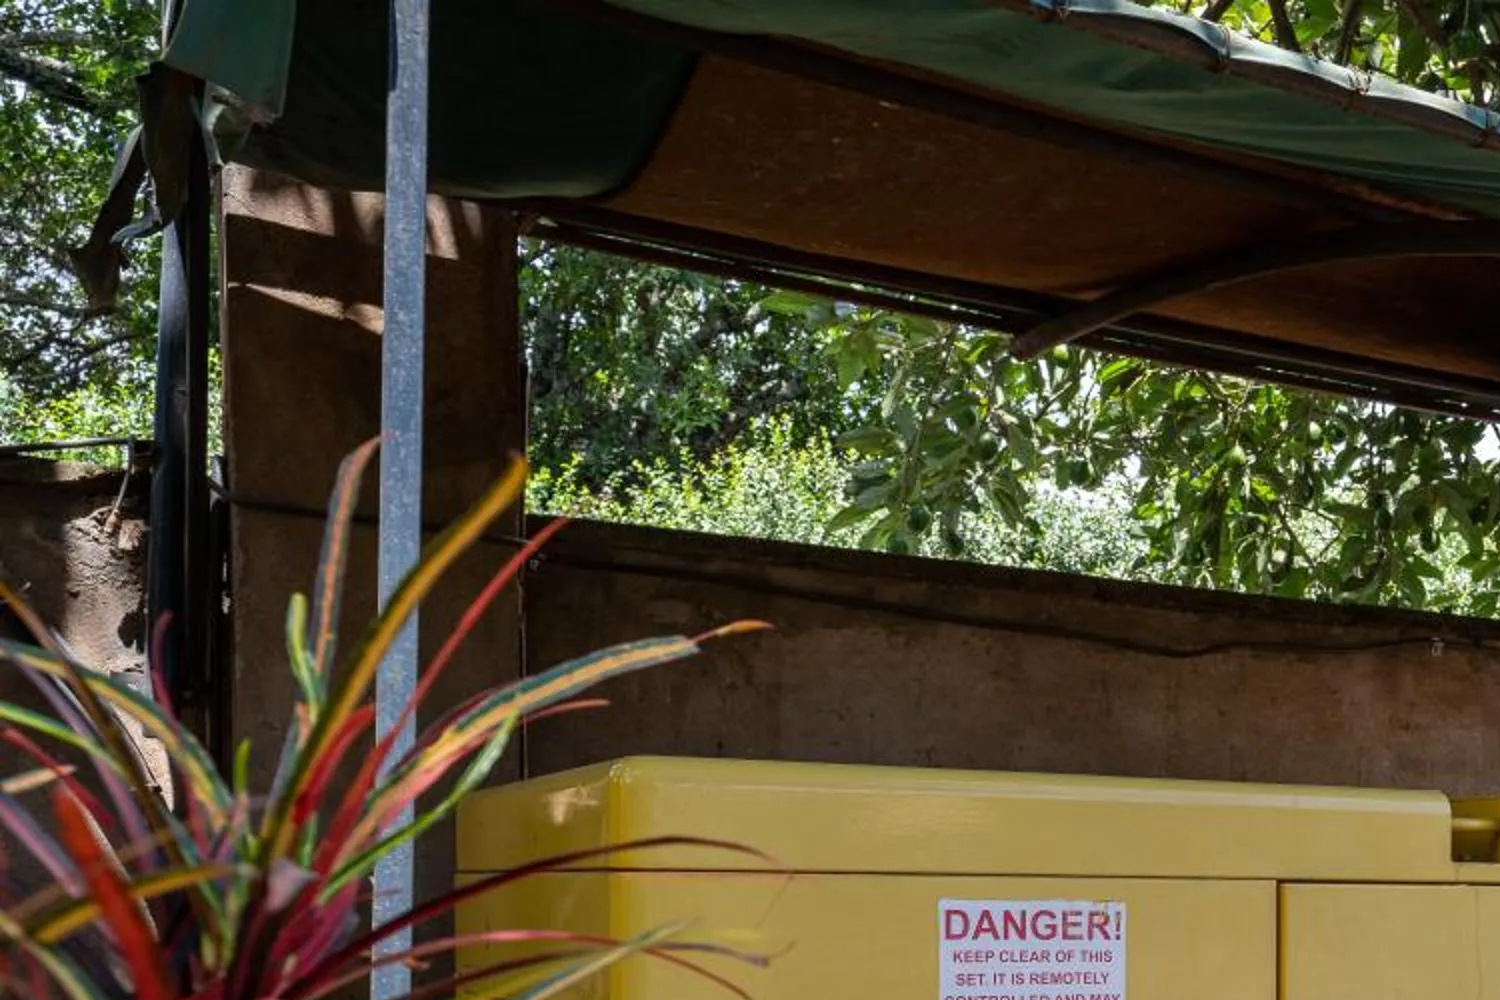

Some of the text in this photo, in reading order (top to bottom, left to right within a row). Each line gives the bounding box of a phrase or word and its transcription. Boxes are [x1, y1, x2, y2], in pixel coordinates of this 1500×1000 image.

[943, 909, 1121, 941] DANGER!
[953, 949, 1113, 963] KEEP CLEAR OF THIS
[993, 973, 1006, 986] IT
[1011, 973, 1025, 986] IS
[1029, 972, 1110, 985] REMOTELY
